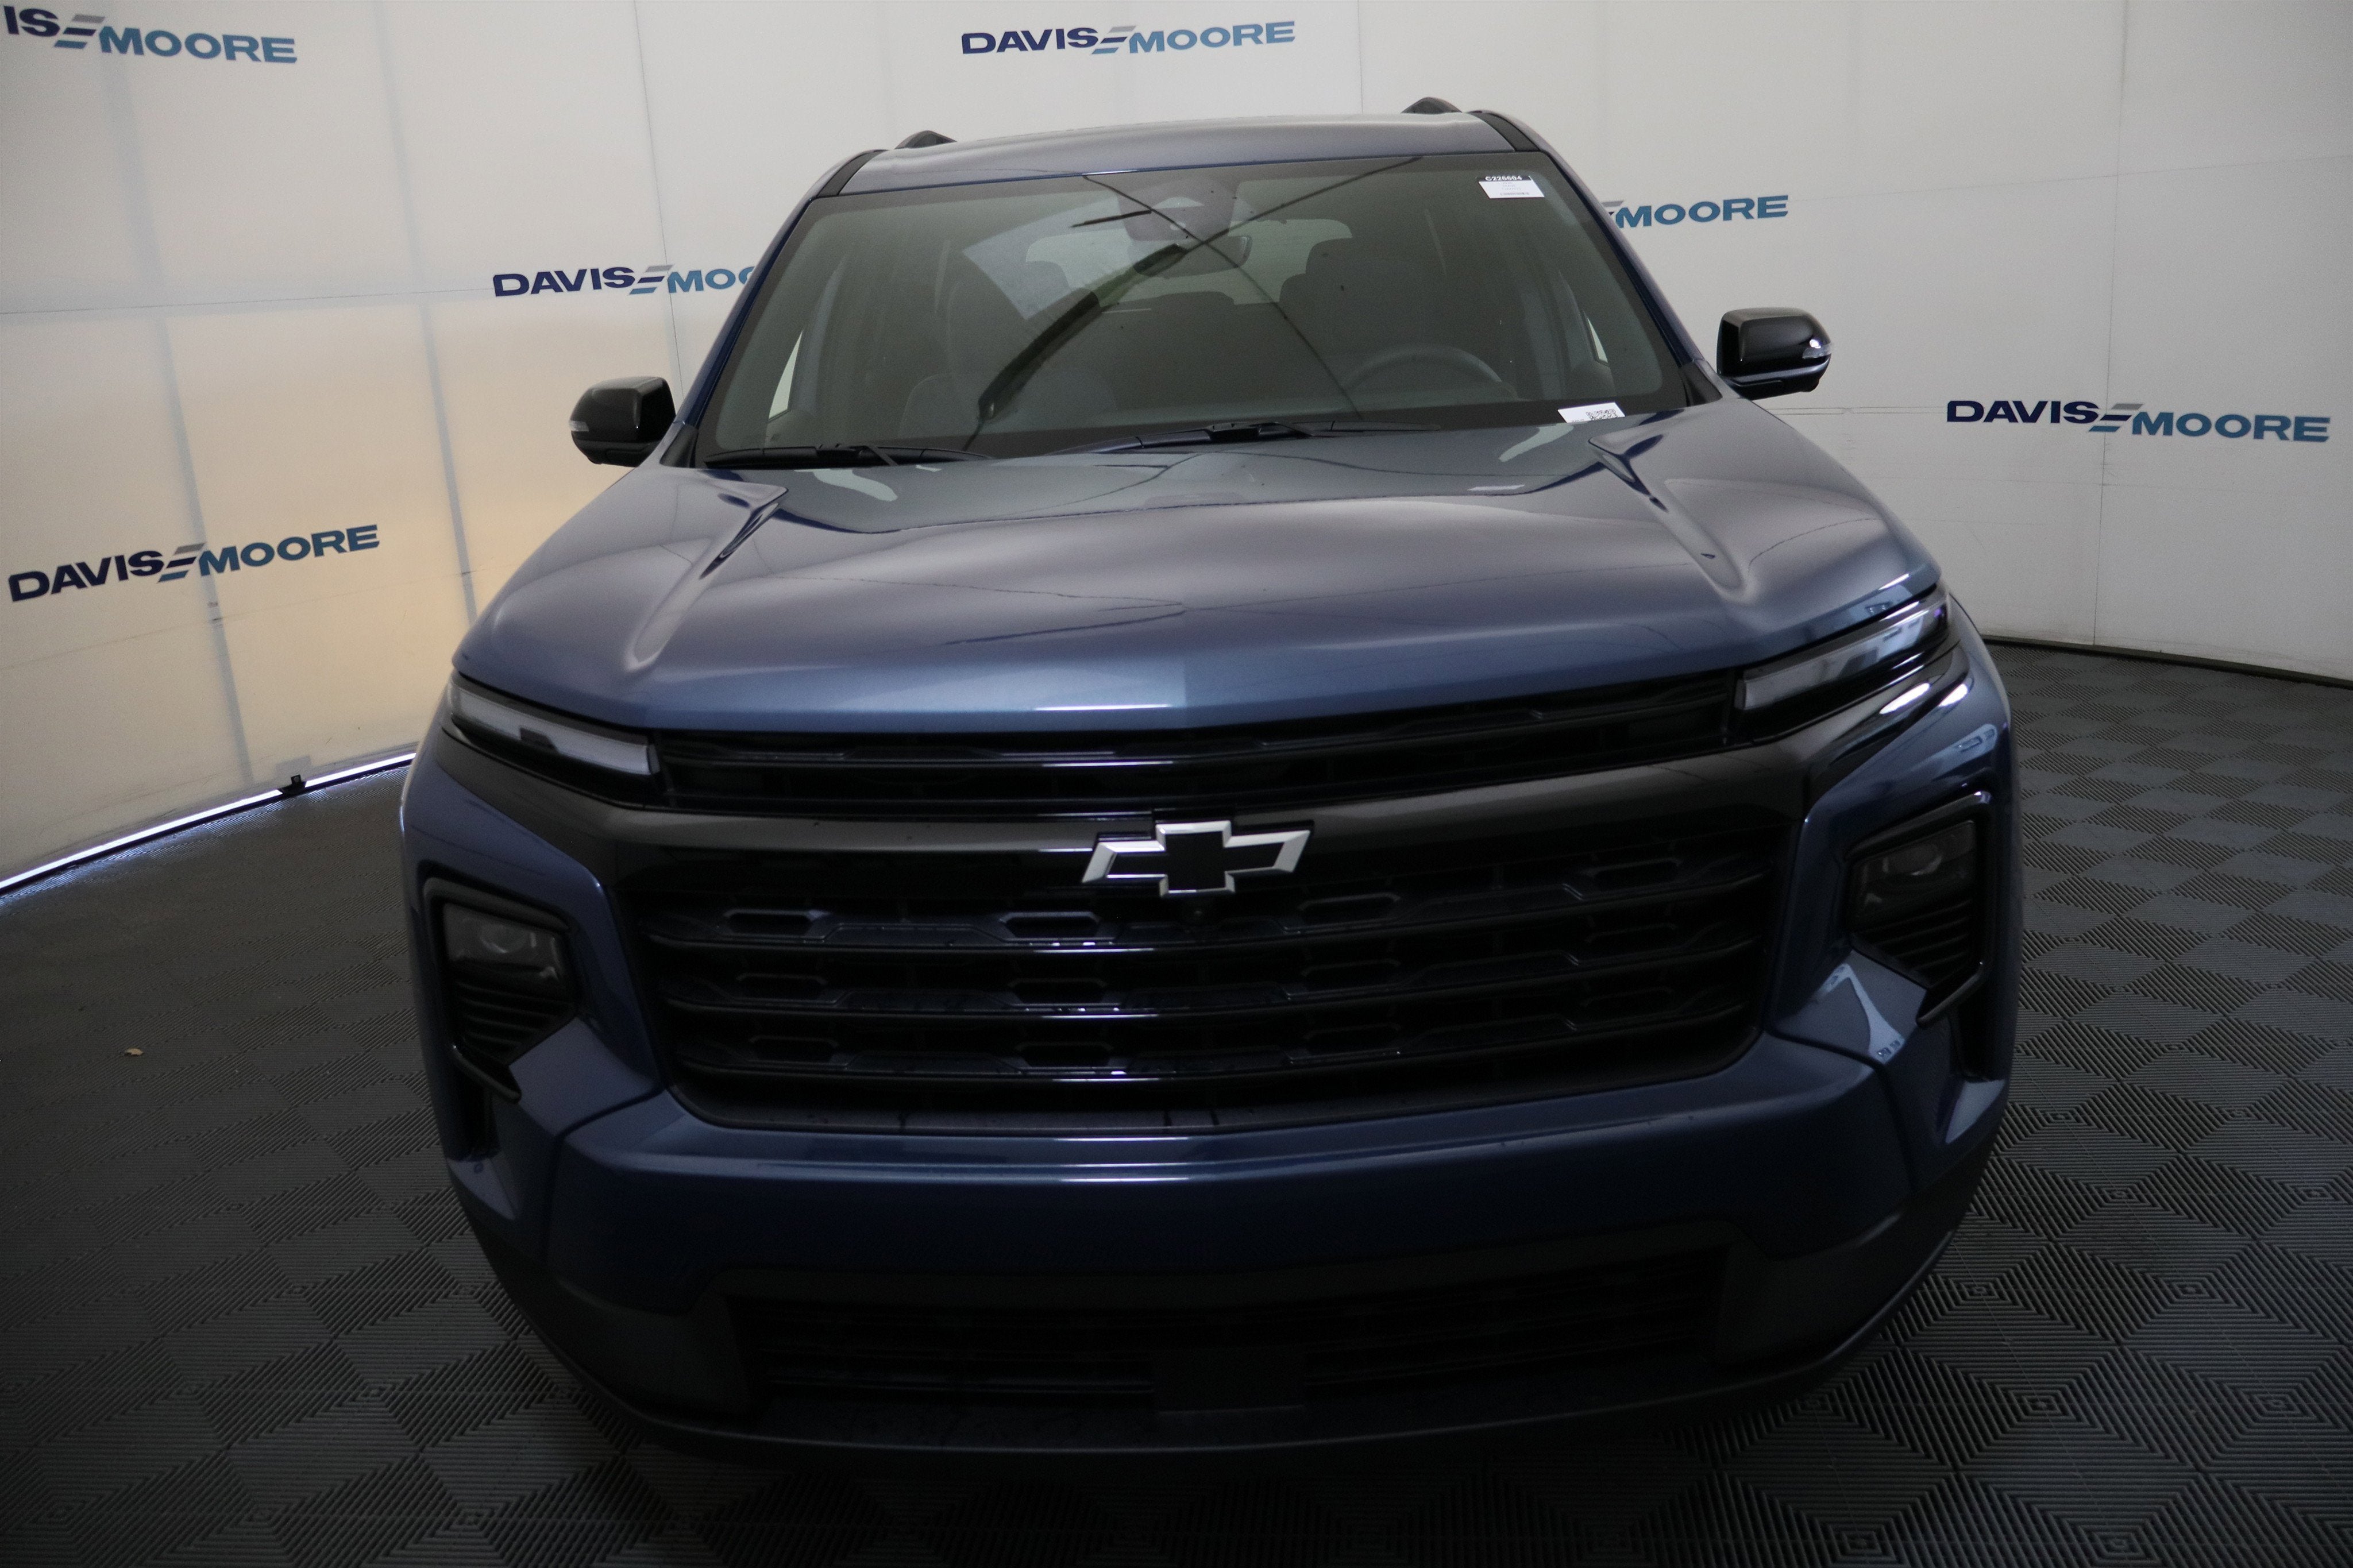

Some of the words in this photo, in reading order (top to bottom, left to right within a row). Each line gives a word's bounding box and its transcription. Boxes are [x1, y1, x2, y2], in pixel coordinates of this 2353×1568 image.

[98, 25, 298, 64] MOORE
[962, 27, 1099, 55] DAVIS
[1129, 21, 1295, 54] MOORE
[1615, 195, 1789, 229] MOORE
[492, 267, 636, 298] DAVIS
[1946, 400, 2100, 424] DAVIS
[2131, 411, 2331, 443] MOORE
[7, 550, 165, 603] DAVIS
[198, 524, 380, 577] MOORE
